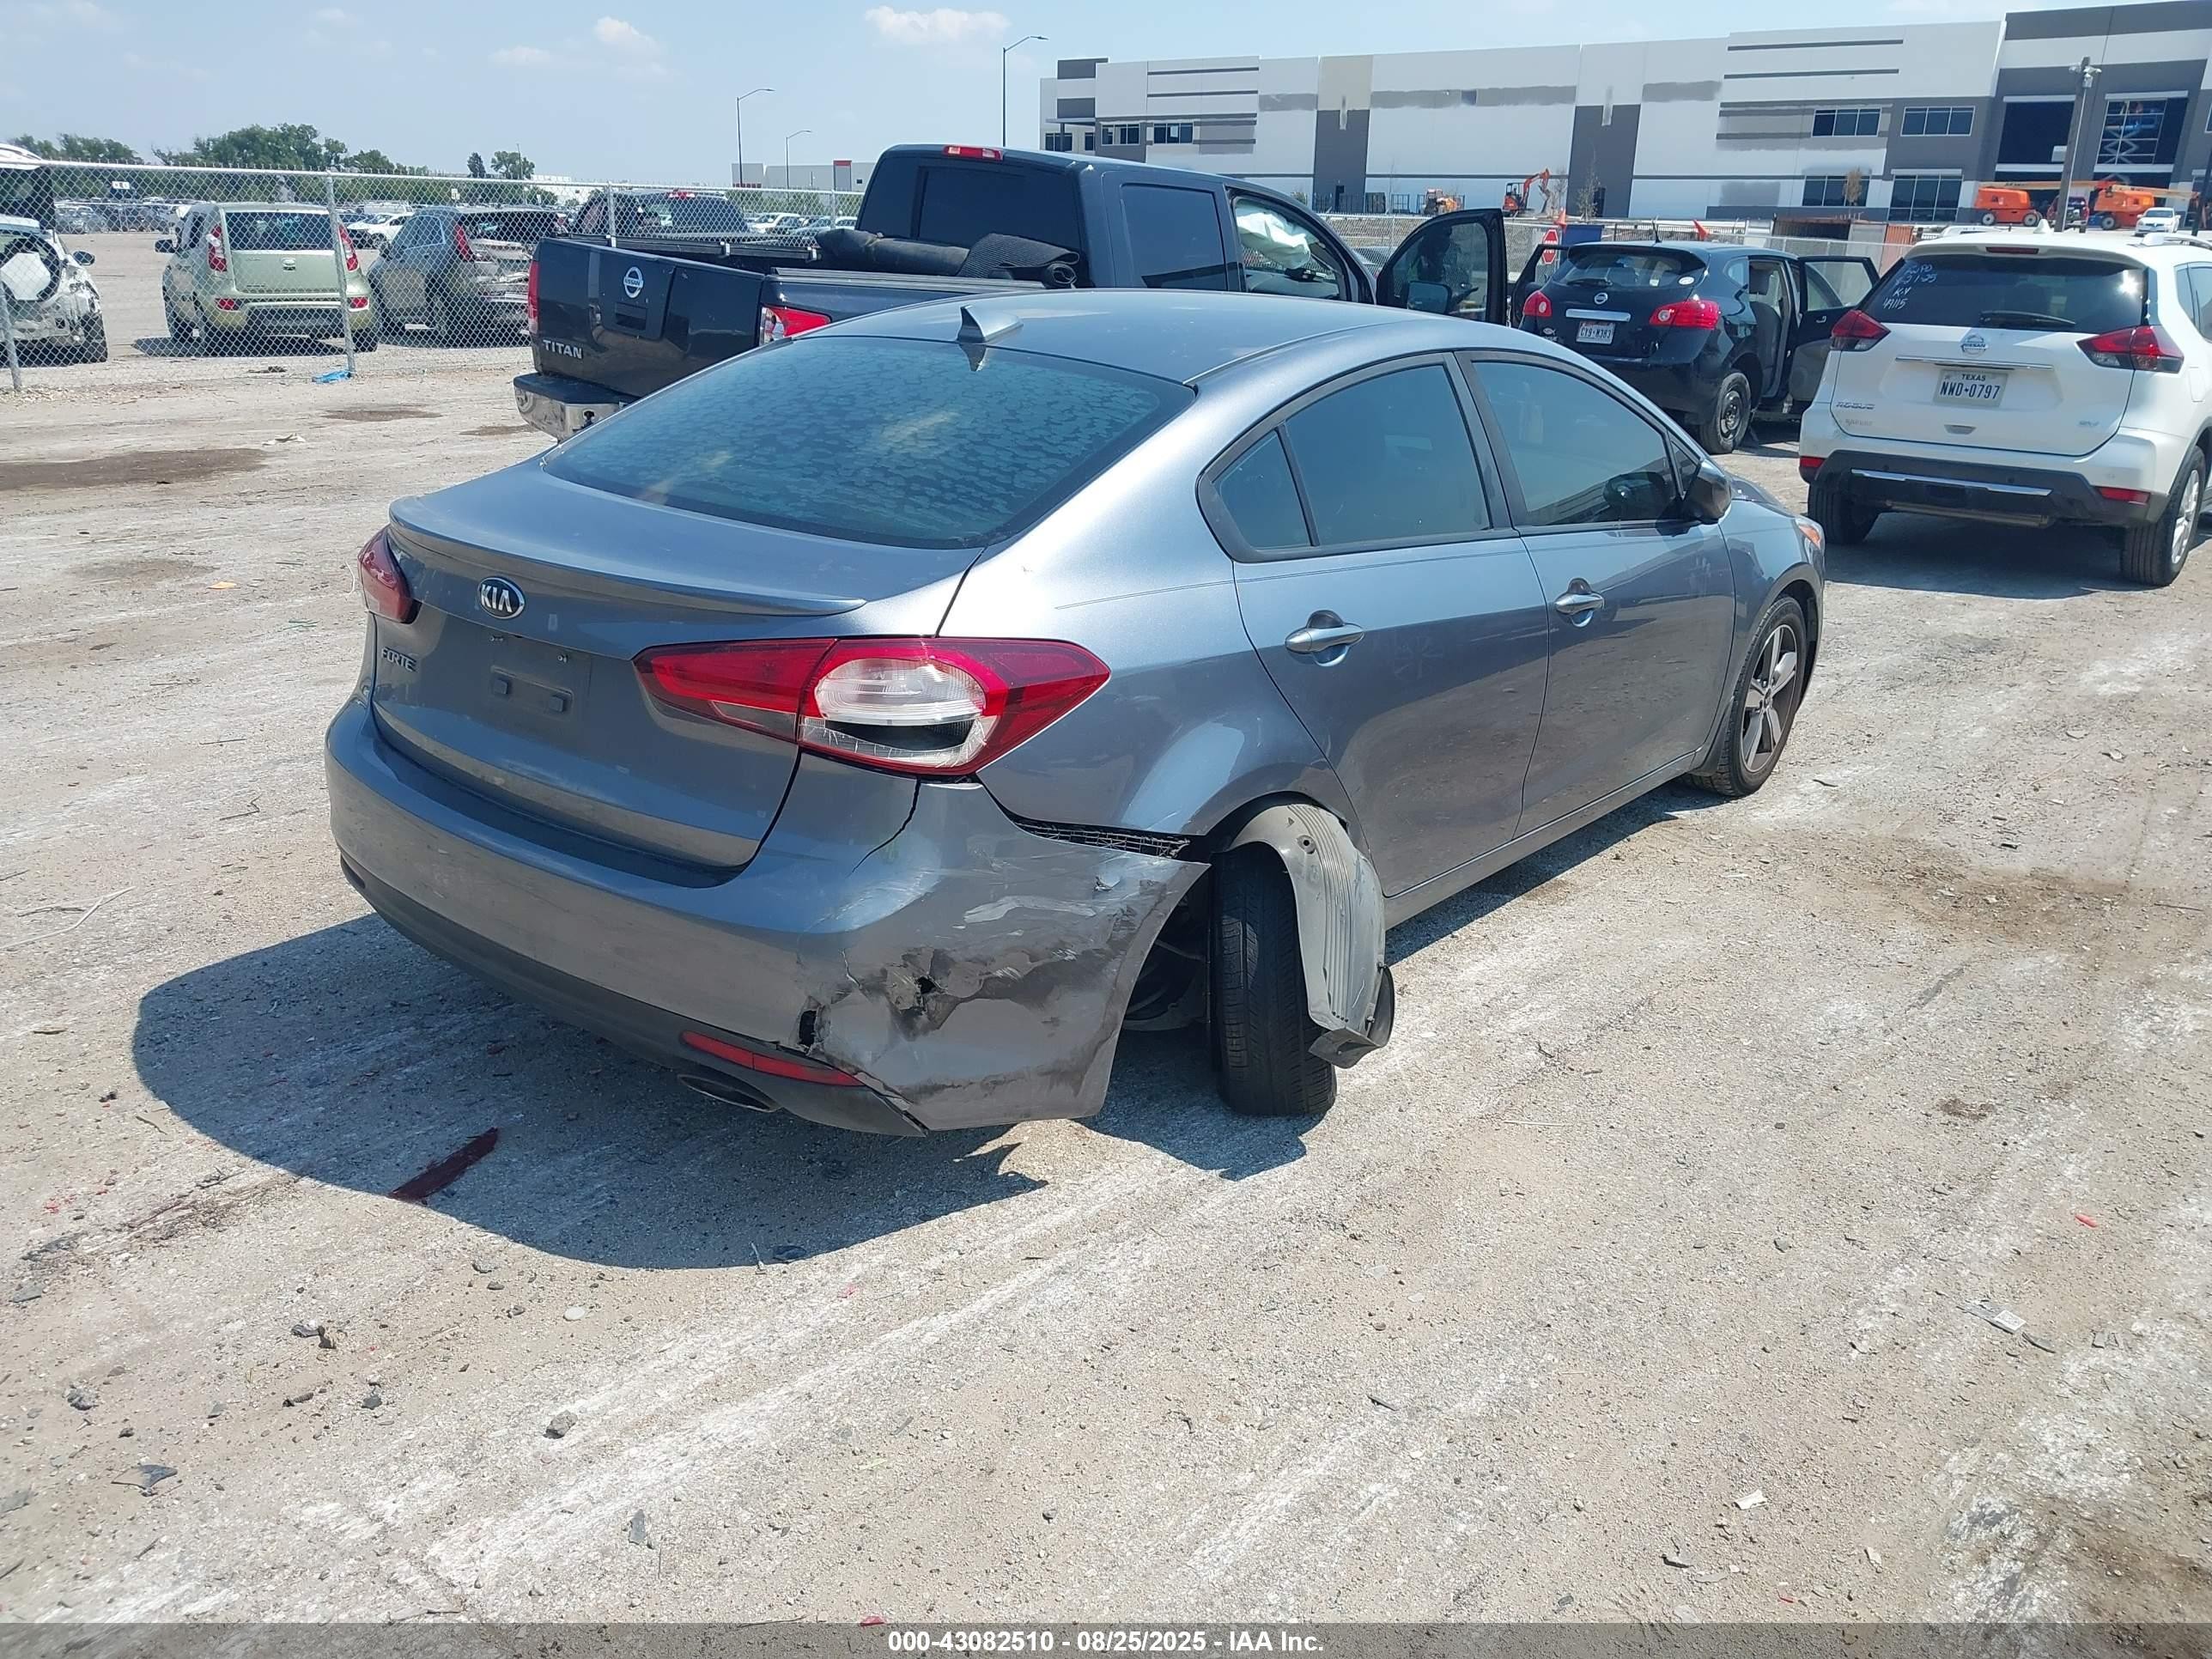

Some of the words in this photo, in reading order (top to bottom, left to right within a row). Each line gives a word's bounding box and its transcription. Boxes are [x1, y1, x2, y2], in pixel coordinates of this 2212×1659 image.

[543, 339, 583, 360] TITAN
[1961, 373, 1986, 382] TEXAS
[480, 584, 513, 613] KIA
[381, 647, 418, 672] FORTE
